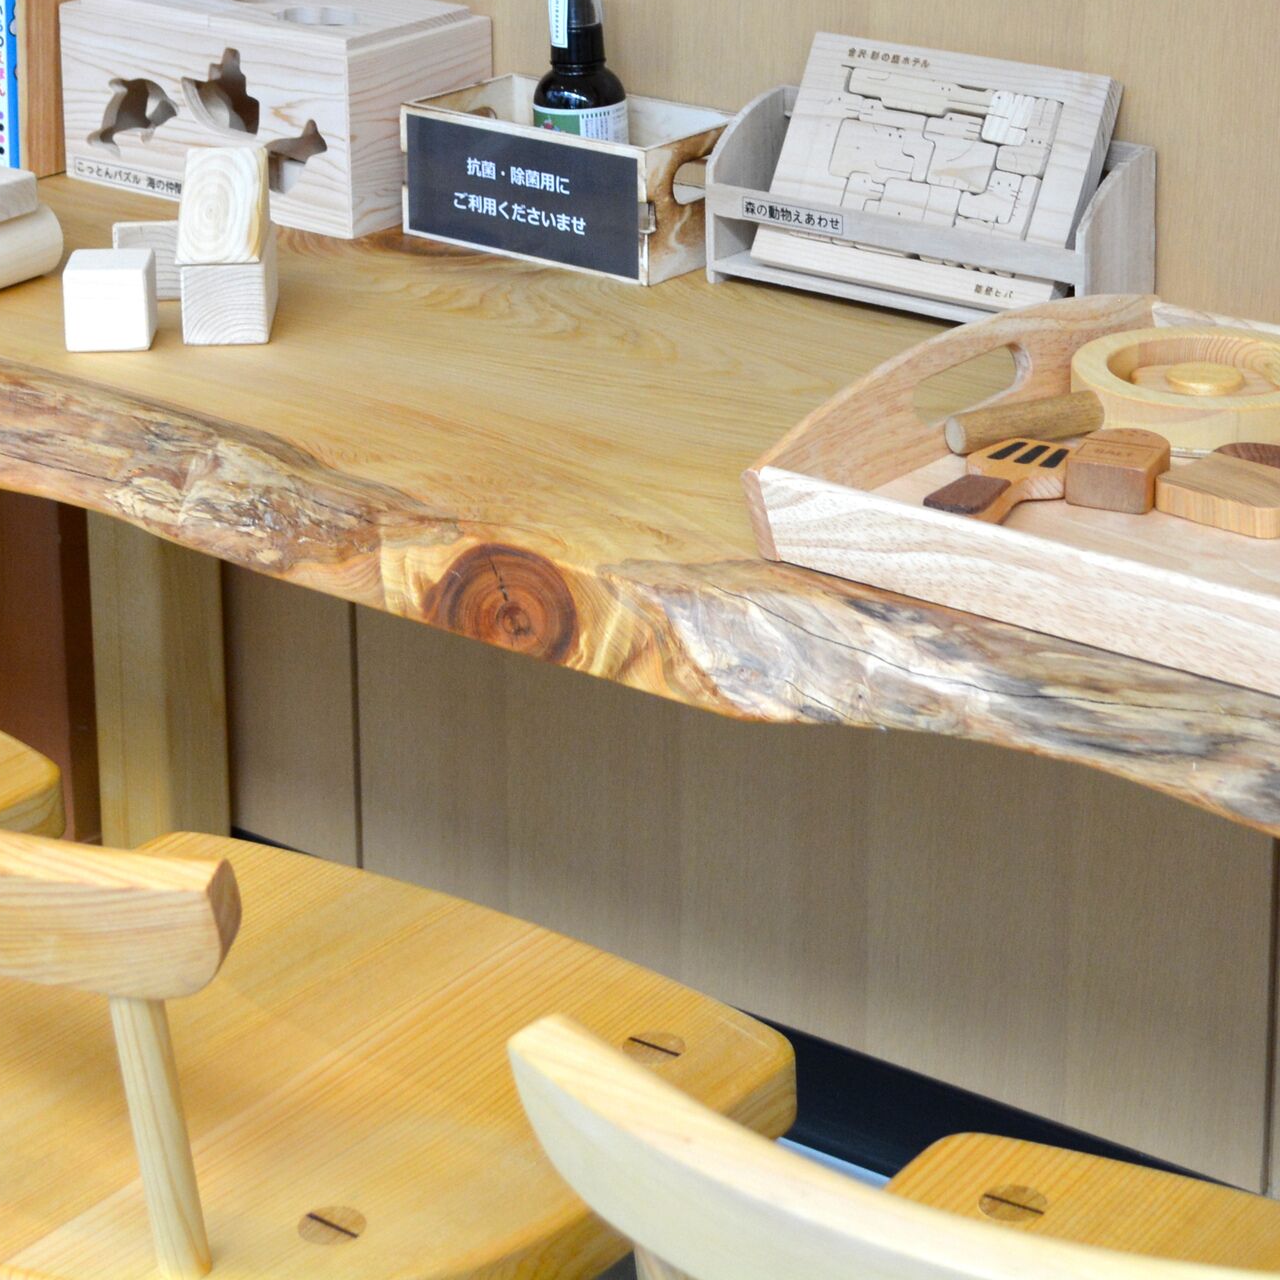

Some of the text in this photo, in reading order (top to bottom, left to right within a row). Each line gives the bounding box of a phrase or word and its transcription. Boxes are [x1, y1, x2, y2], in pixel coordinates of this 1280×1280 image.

[466, 157, 571, 195] 抗菌・除菌用に
[453, 192, 587, 236] ご利用くださいませ
[745, 201, 840, 230] 森の動物えあわせ
